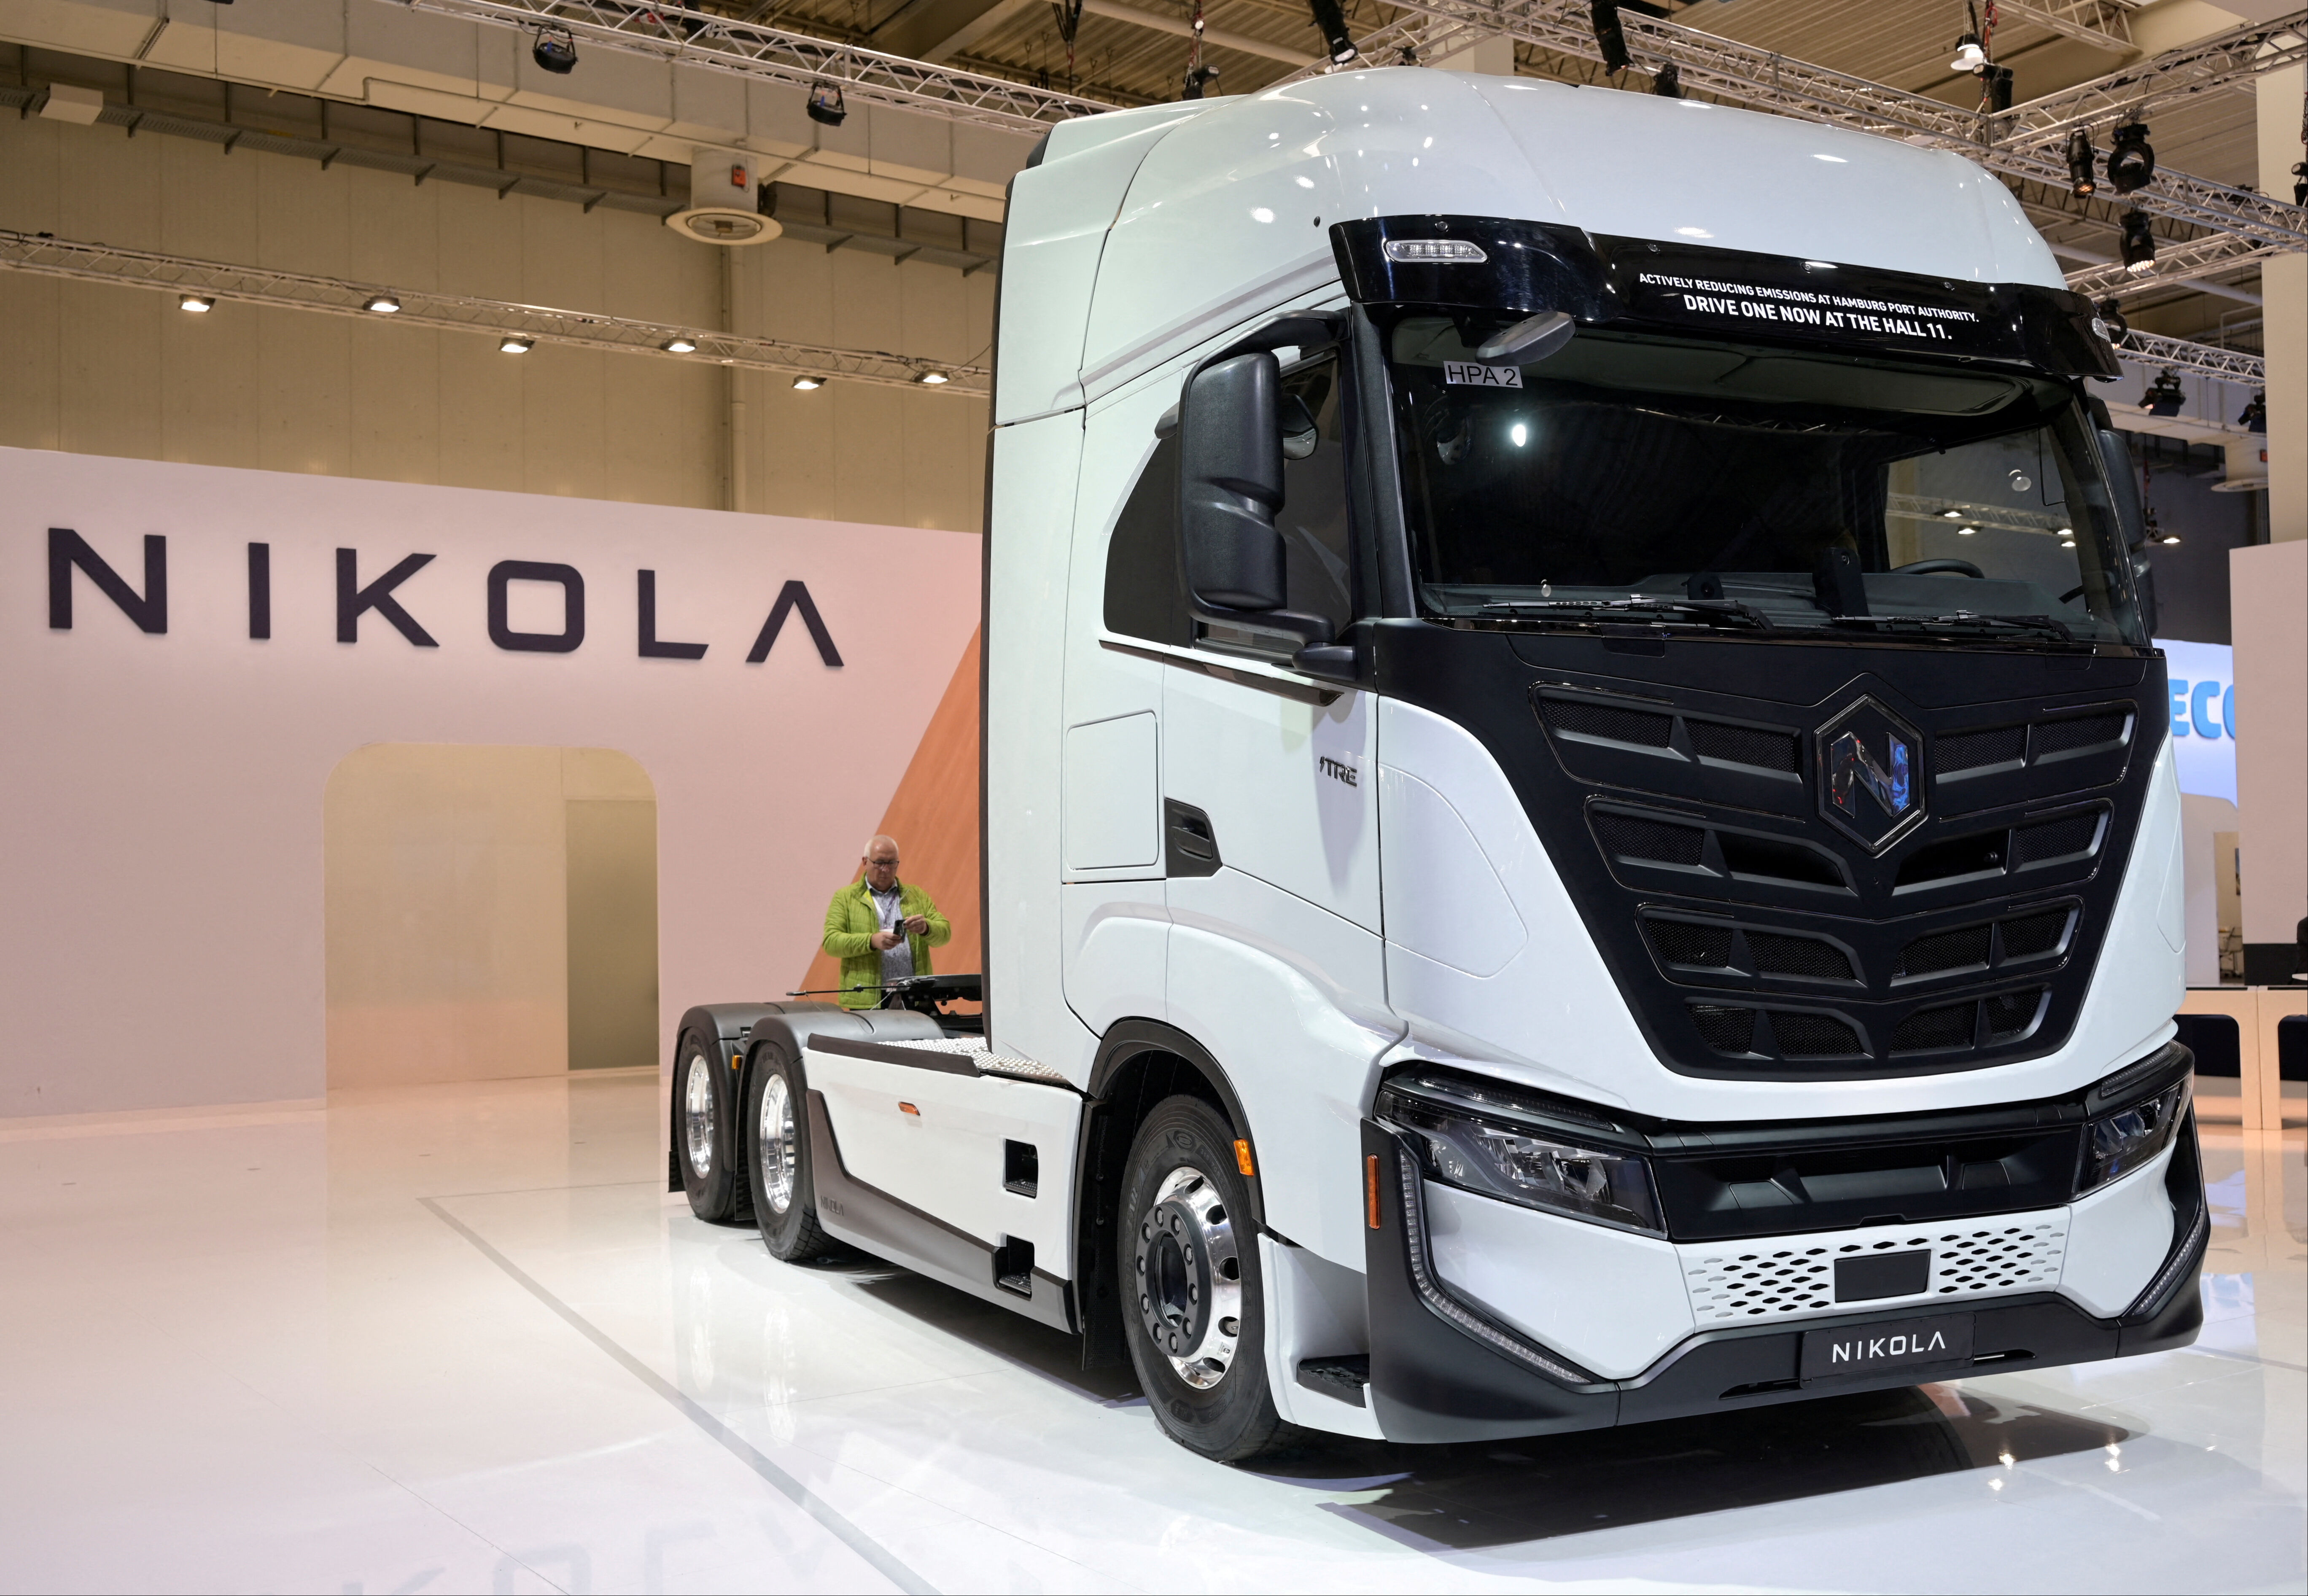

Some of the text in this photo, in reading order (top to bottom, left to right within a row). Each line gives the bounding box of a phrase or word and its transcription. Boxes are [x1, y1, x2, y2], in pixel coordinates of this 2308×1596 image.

[1640, 273, 1979, 322] ACTIVELY REDUCING EMISSIONS AT HAMBURG PORT AUTHORITY.
[1683, 294, 1953, 339] DRIVE ONE NOW AT THE HALL 11.
[1448, 365, 1518, 386] HPA 2
[47, 527, 845, 668] NIKOLA
[820, 1195, 844, 1216] NIKOLA
[1832, 1331, 1946, 1363] NIKOLA
